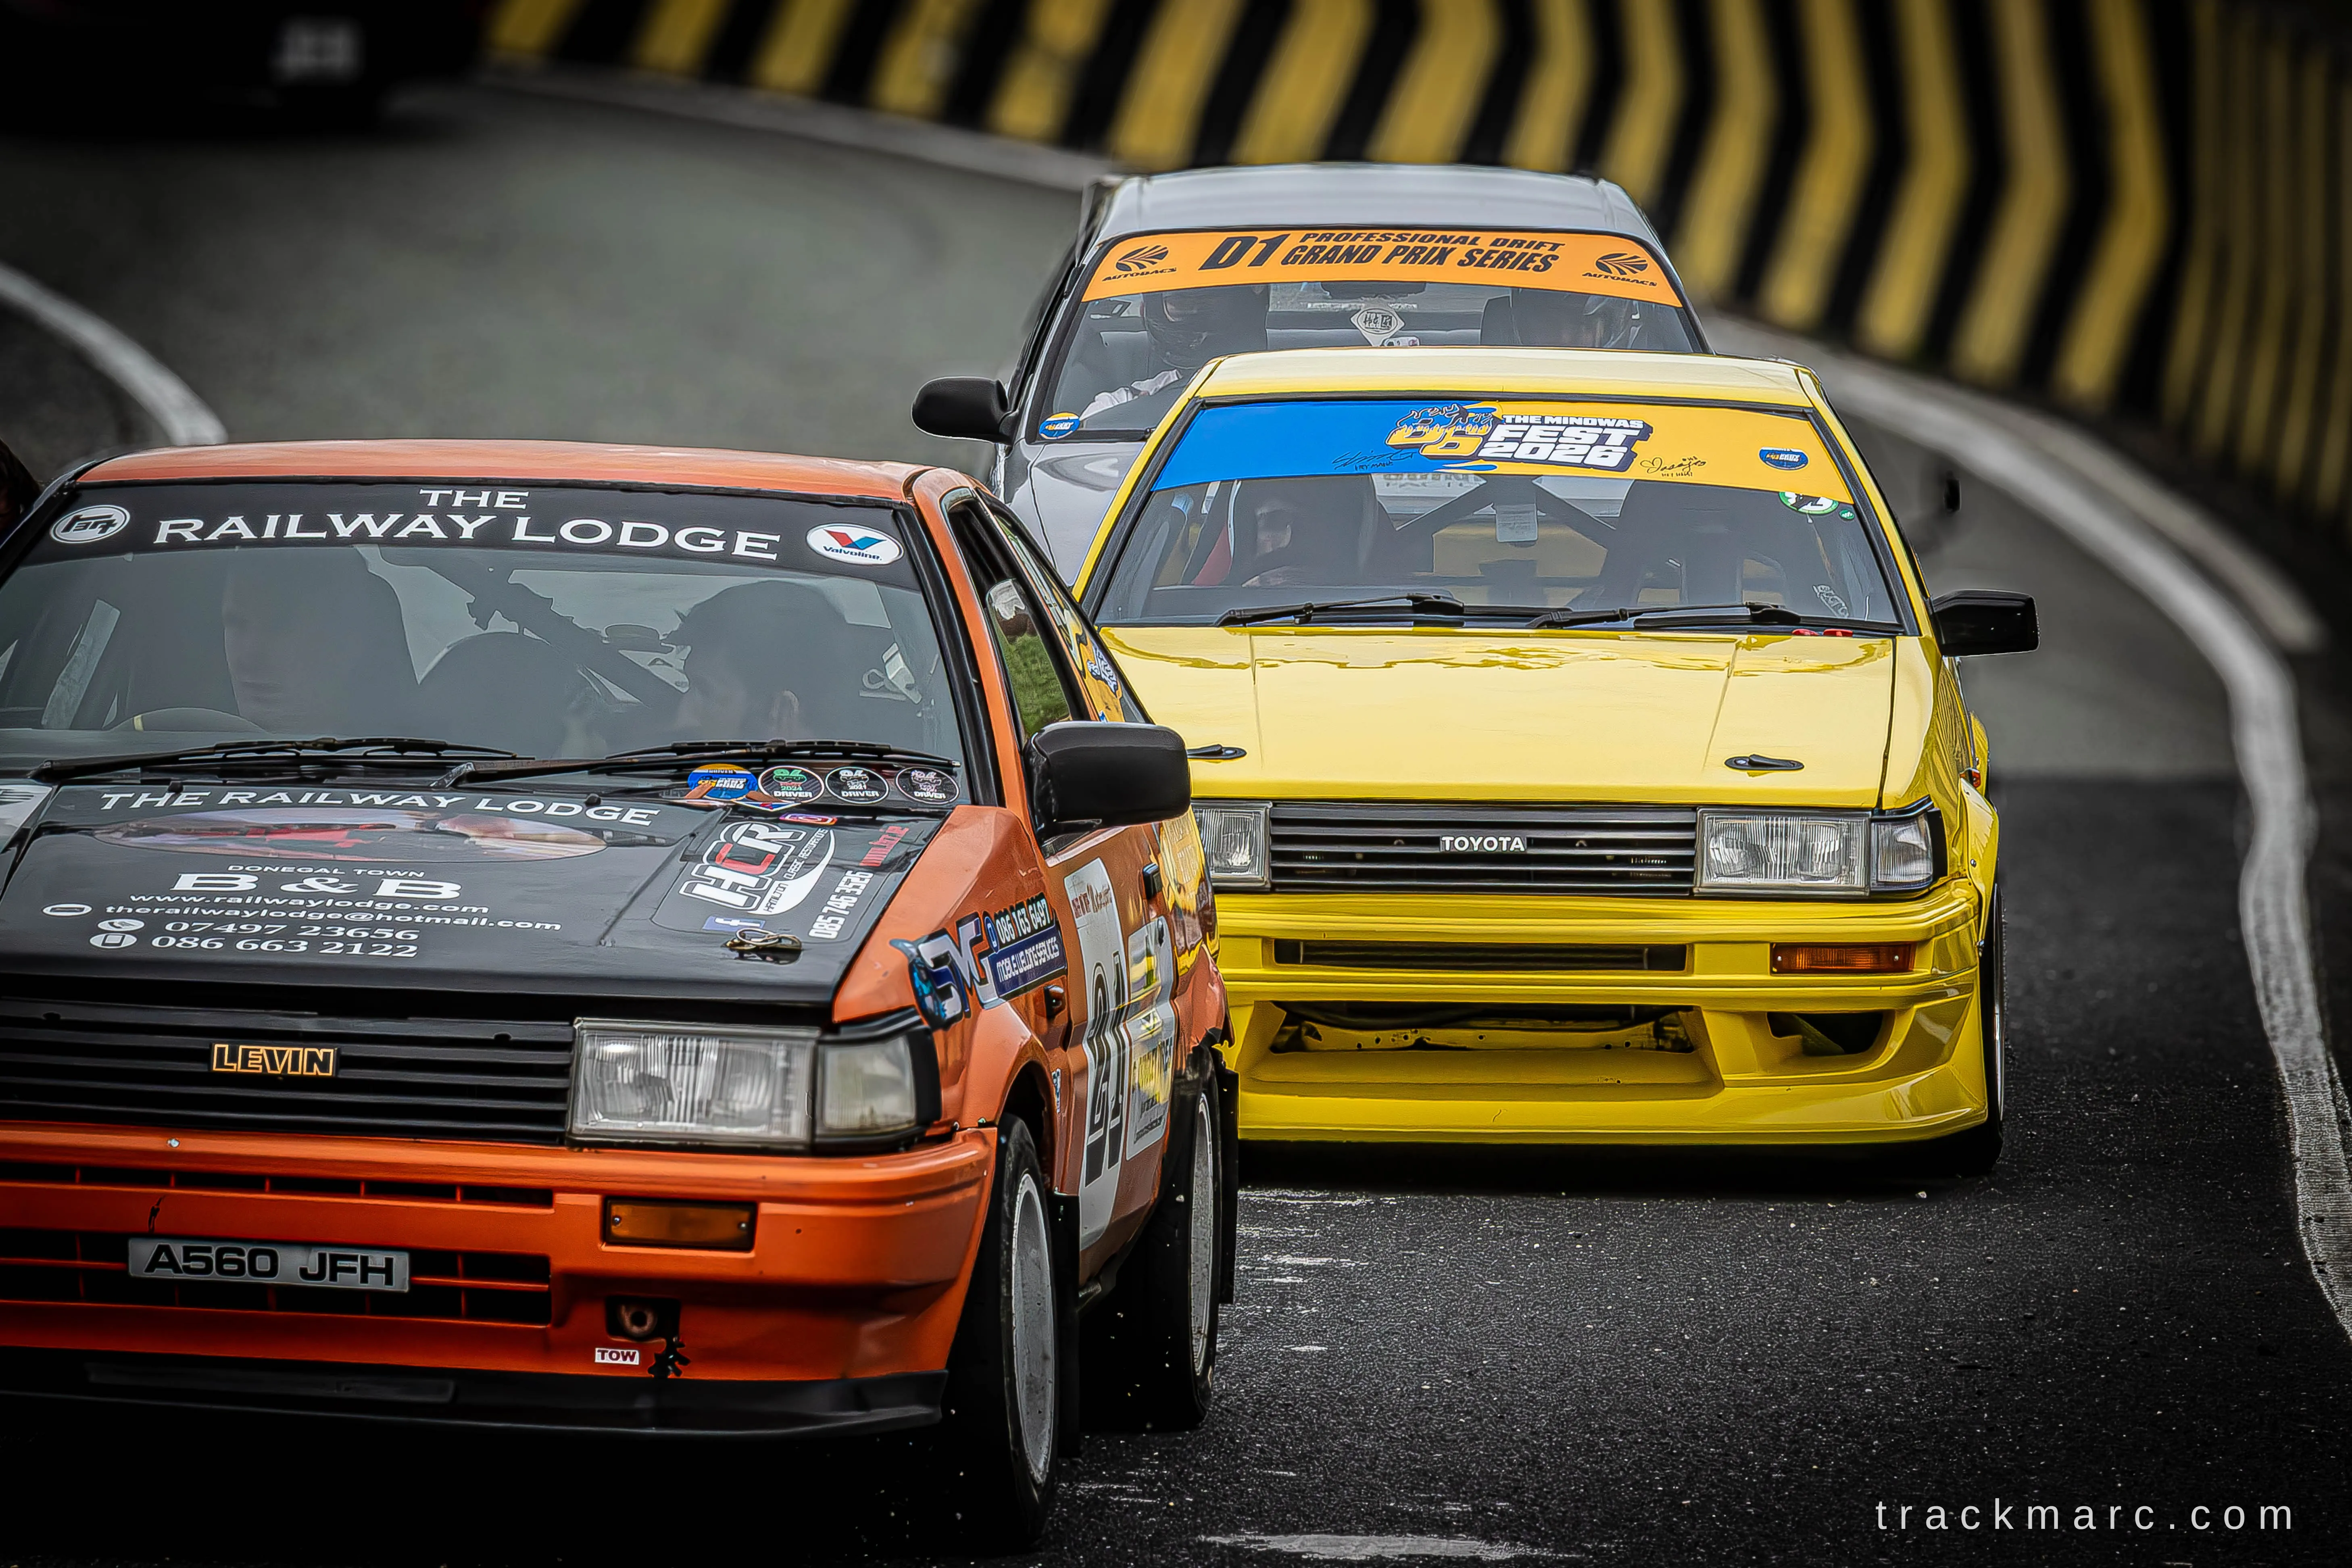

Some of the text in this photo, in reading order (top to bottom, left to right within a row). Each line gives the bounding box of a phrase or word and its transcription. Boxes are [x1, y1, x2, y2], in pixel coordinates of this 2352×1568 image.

[1198, 234, 1290, 271] D1
[1299, 232, 1566, 252] PROFESSIONAL DRIFT
[1281, 244, 1560, 273] GRAND PRIX SERIES
[1101, 267, 1177, 282] AUTOBACS
[1582, 272, 1658, 287] AUTOBACS
[1503, 414, 1644, 429] THE MINOWAS
[1486, 424, 1639, 446] FEST
[1478, 441, 1628, 467] 2026
[419, 489, 529, 509] THE
[153, 513, 781, 561] RAILWAY LODGE
[913, 791, 946, 799] DRIVER
[101, 791, 660, 826] THE RAILWAY LODGE
[1441, 836, 1526, 852] TOYOTA
[228, 865, 425, 878] DONEGAL TOWN
[684, 822, 801, 909] HCR
[170, 873, 462, 899] B & B
[809, 871, 874, 938] 085 746 3526
[165, 922, 420, 940] 07497 23656
[996, 913, 1015, 944] 086
[1028, 898, 1050, 930] 6497
[151, 936, 418, 958] 086 663 2122
[213, 1044, 335, 1076] LEVIN
[144, 1243, 394, 1287] A560 JFH
[598, 1349, 636, 1362] TOW
